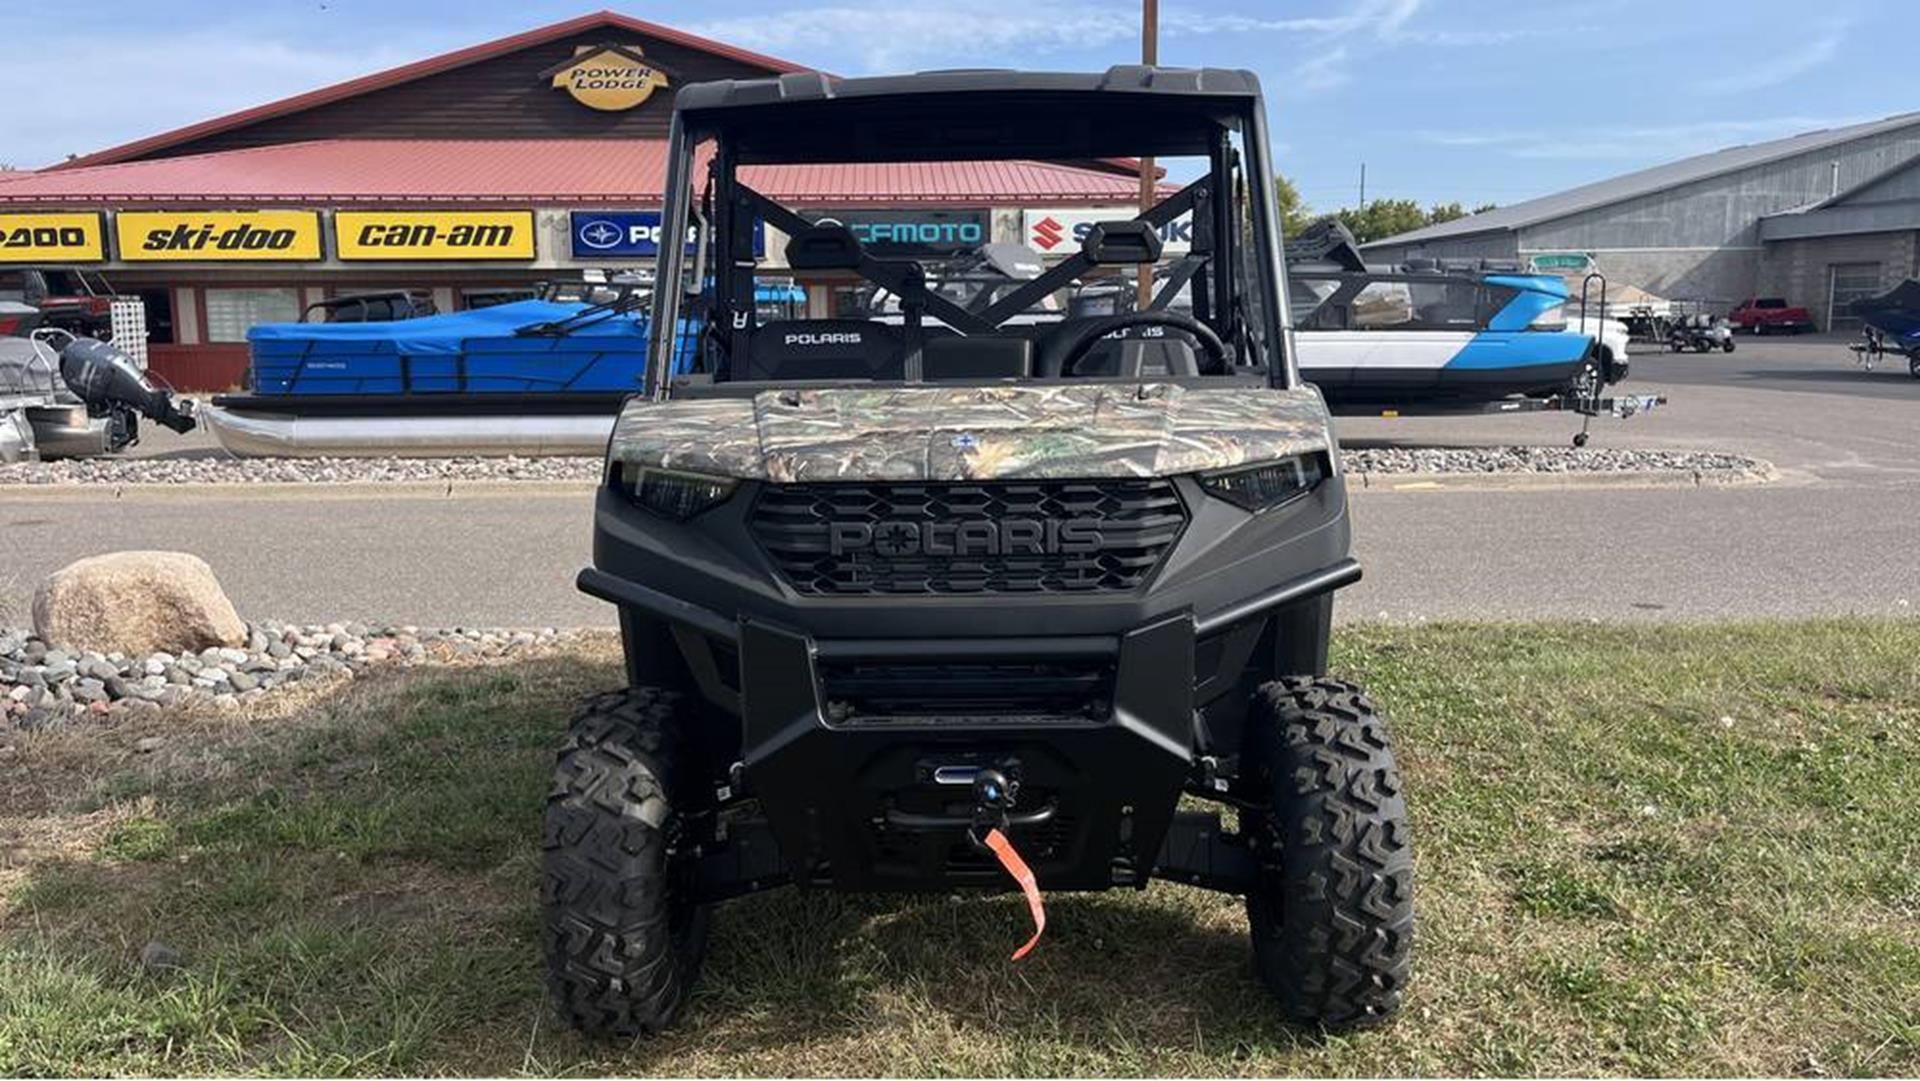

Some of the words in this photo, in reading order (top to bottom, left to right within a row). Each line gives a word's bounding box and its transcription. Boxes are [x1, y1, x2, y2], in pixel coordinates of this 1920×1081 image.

[570, 67, 651, 80] POWER
[575, 78, 646, 89] LODGE
[785, 333, 862, 345] POLARIS
[829, 520, 1104, 556] POLARIS
